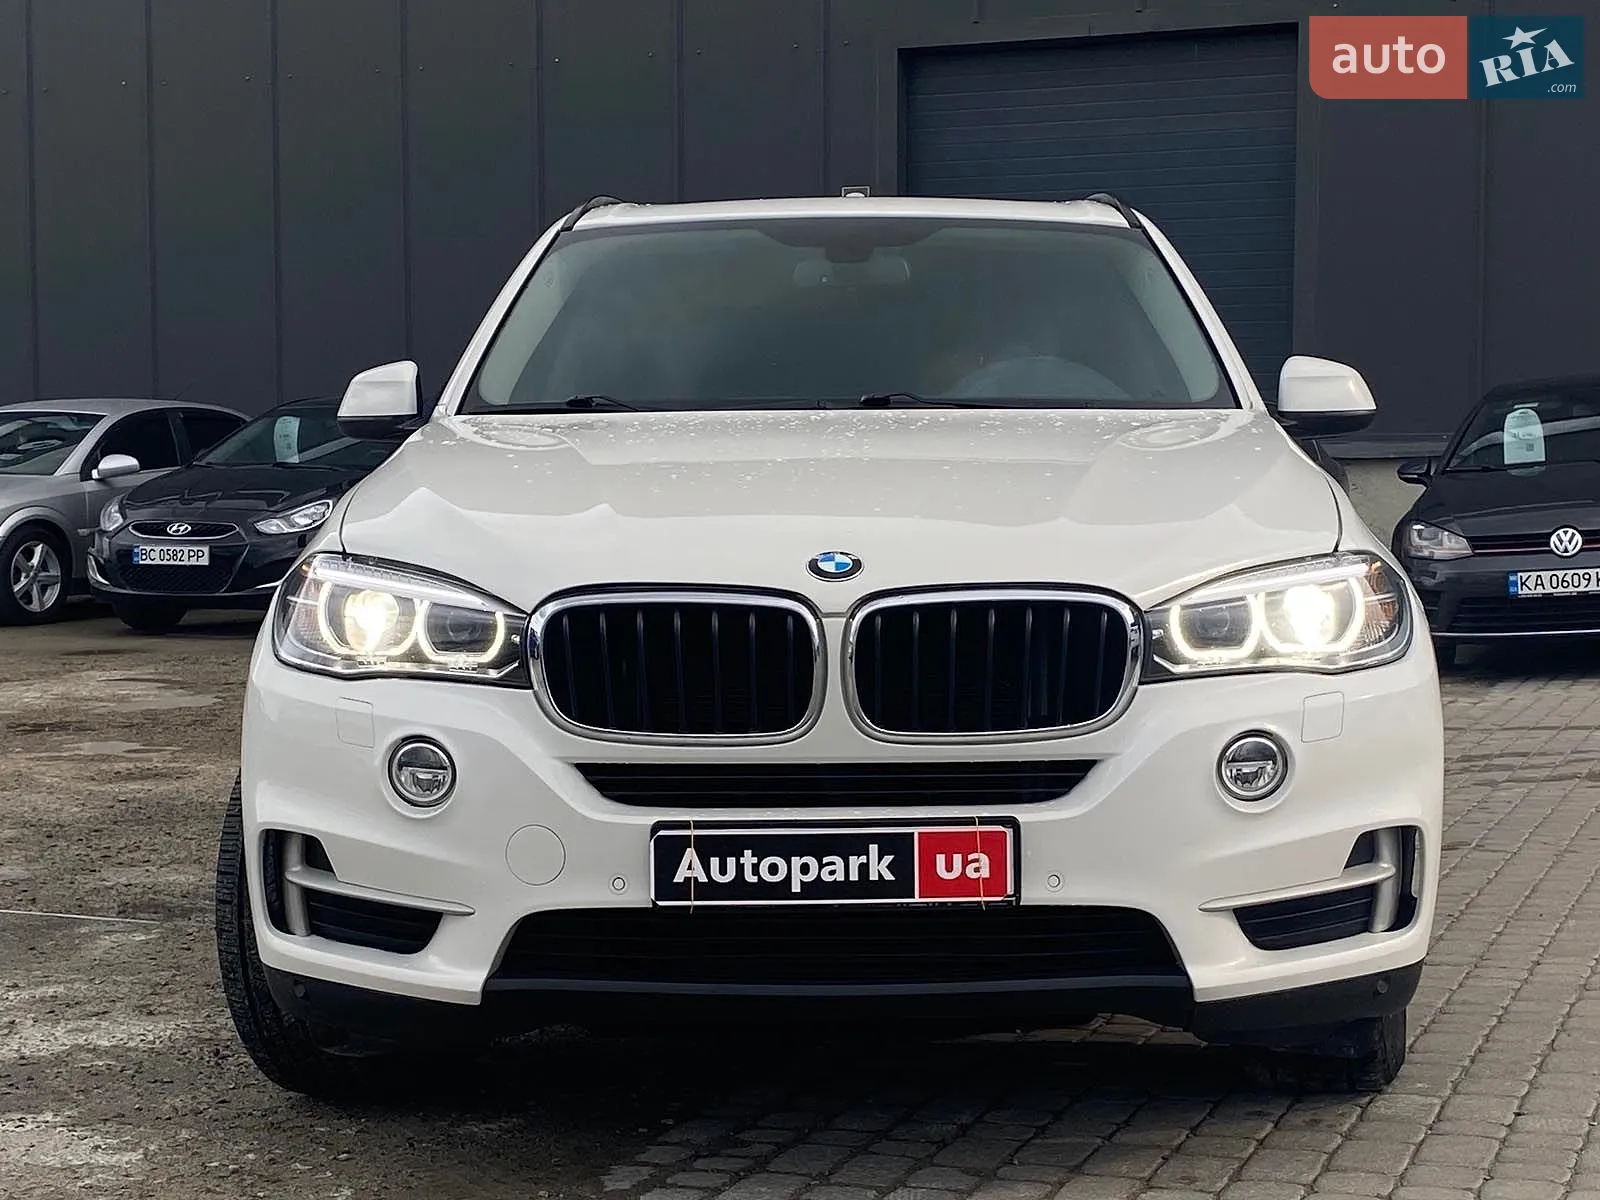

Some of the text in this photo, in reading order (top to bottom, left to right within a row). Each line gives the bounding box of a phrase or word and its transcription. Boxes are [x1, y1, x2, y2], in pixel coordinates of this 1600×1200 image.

[140, 548, 157, 562] BC
[158, 548, 185, 562] 0582
[187, 548, 205, 563] PP
[1519, 574, 1546, 592] KA
[1549, 571, 1592, 590] 0609
[672, 843, 991, 893] Autopark ua
